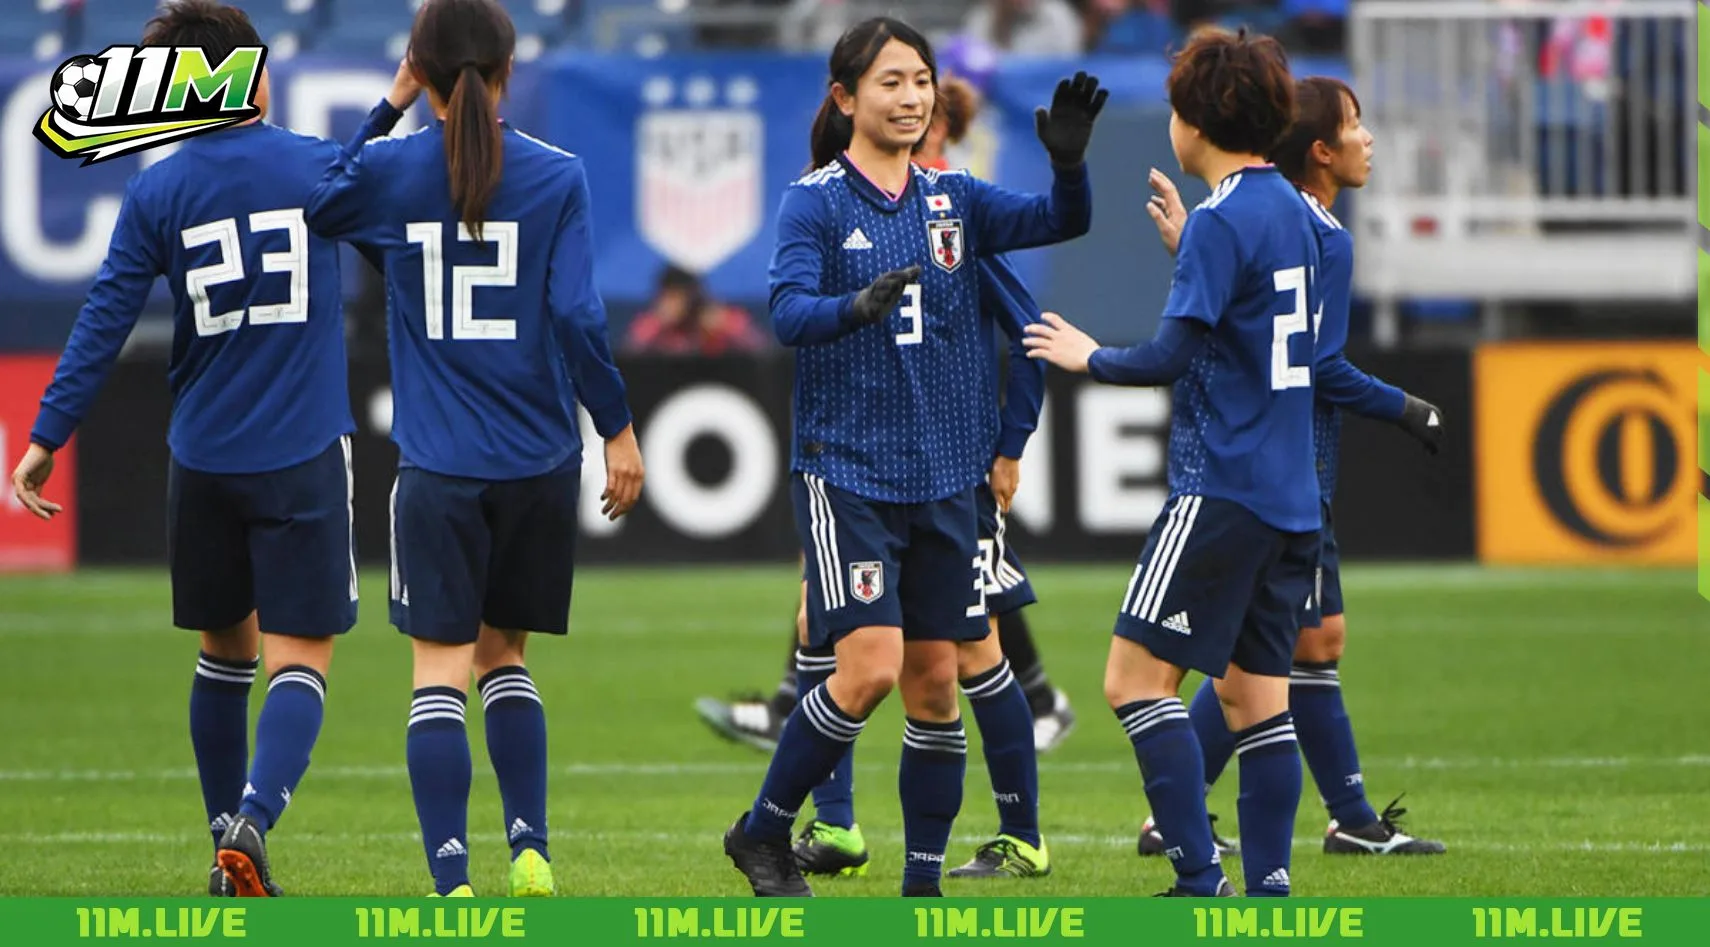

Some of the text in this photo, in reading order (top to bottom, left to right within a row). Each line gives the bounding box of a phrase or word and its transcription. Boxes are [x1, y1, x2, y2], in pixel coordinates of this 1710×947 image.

[181, 209, 308, 336] 23
[407, 222, 519, 340] 12
[895, 284, 922, 345] 3
